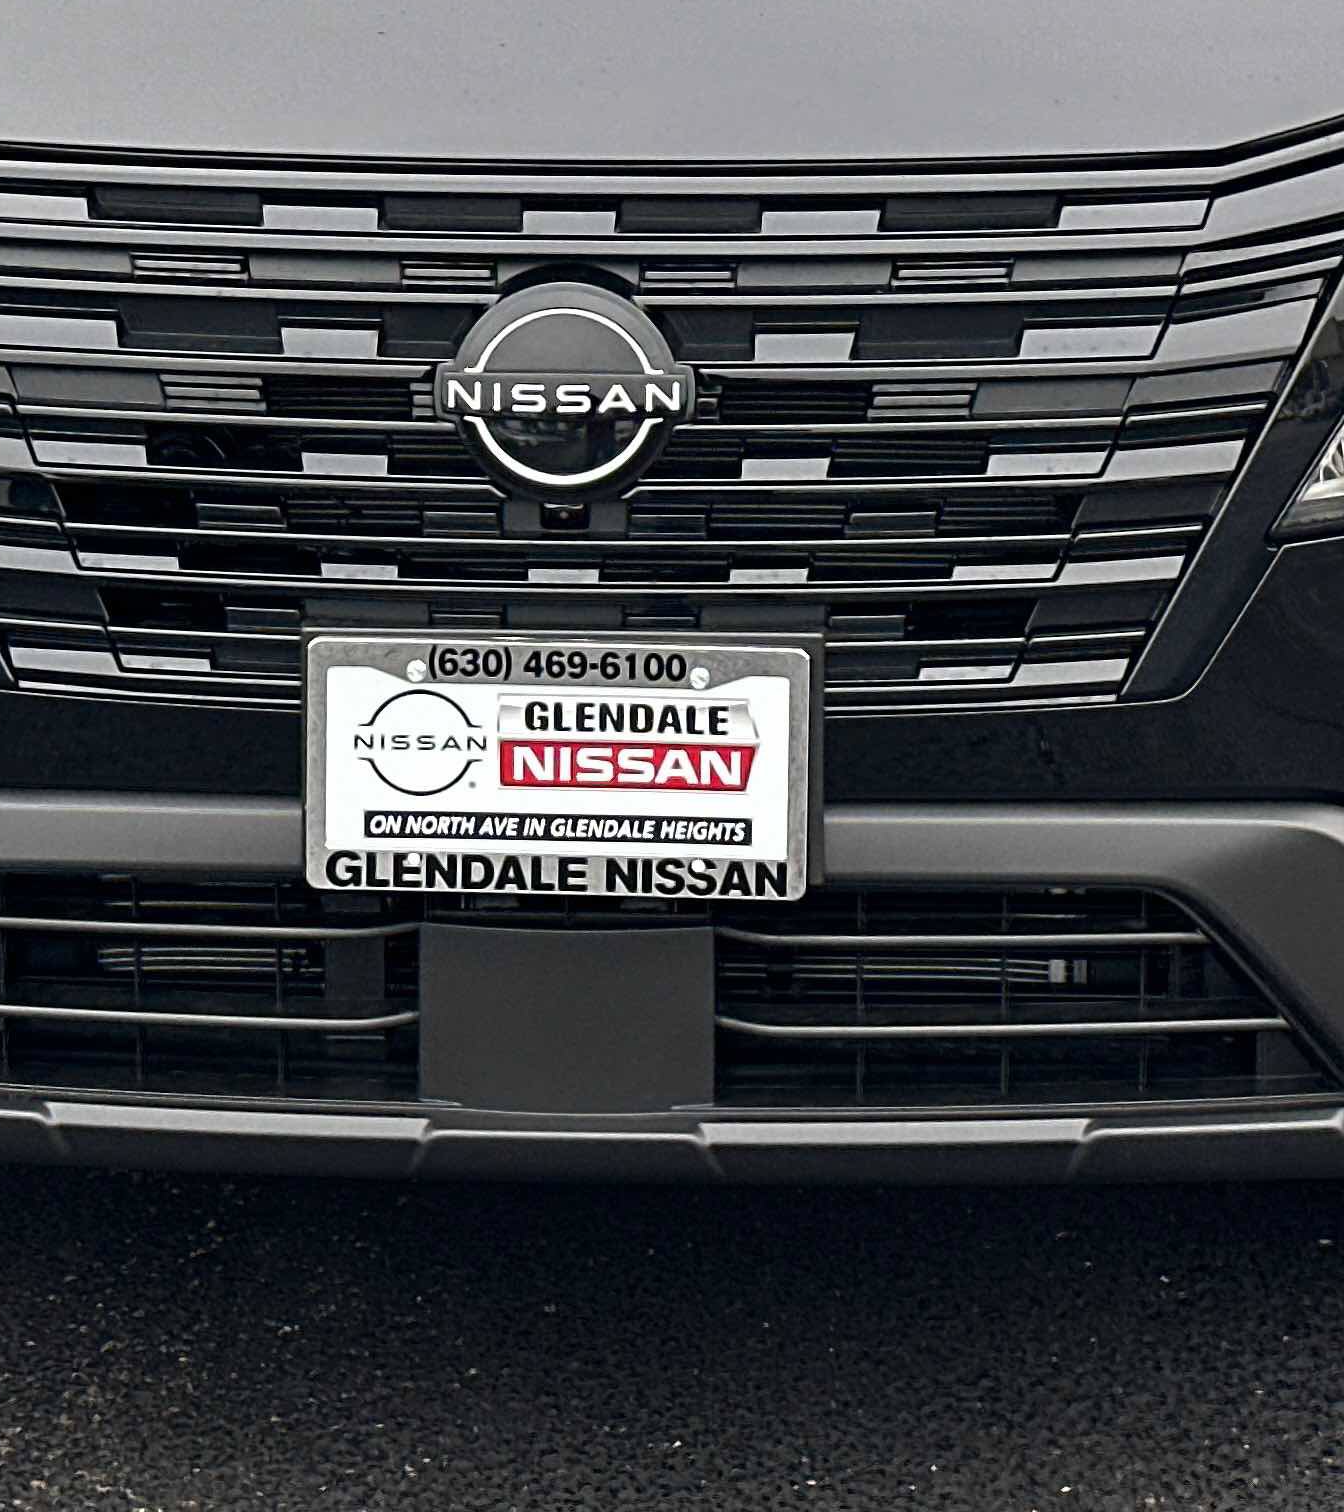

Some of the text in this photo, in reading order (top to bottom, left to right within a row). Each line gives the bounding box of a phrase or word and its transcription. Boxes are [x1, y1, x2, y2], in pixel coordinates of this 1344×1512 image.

[446, 379, 681, 414] NISSAN
[428, 644, 687, 682] (630) 469-6100
[524, 701, 729, 736] GLENDALE
[354, 734, 488, 751] NISSAN
[512, 745, 743, 786] NISSAN
[369, 814, 747, 842] ON NORTH AVE IN GLENDALE HEIGHTS
[325, 849, 788, 897] GLENDALE NISSAN
